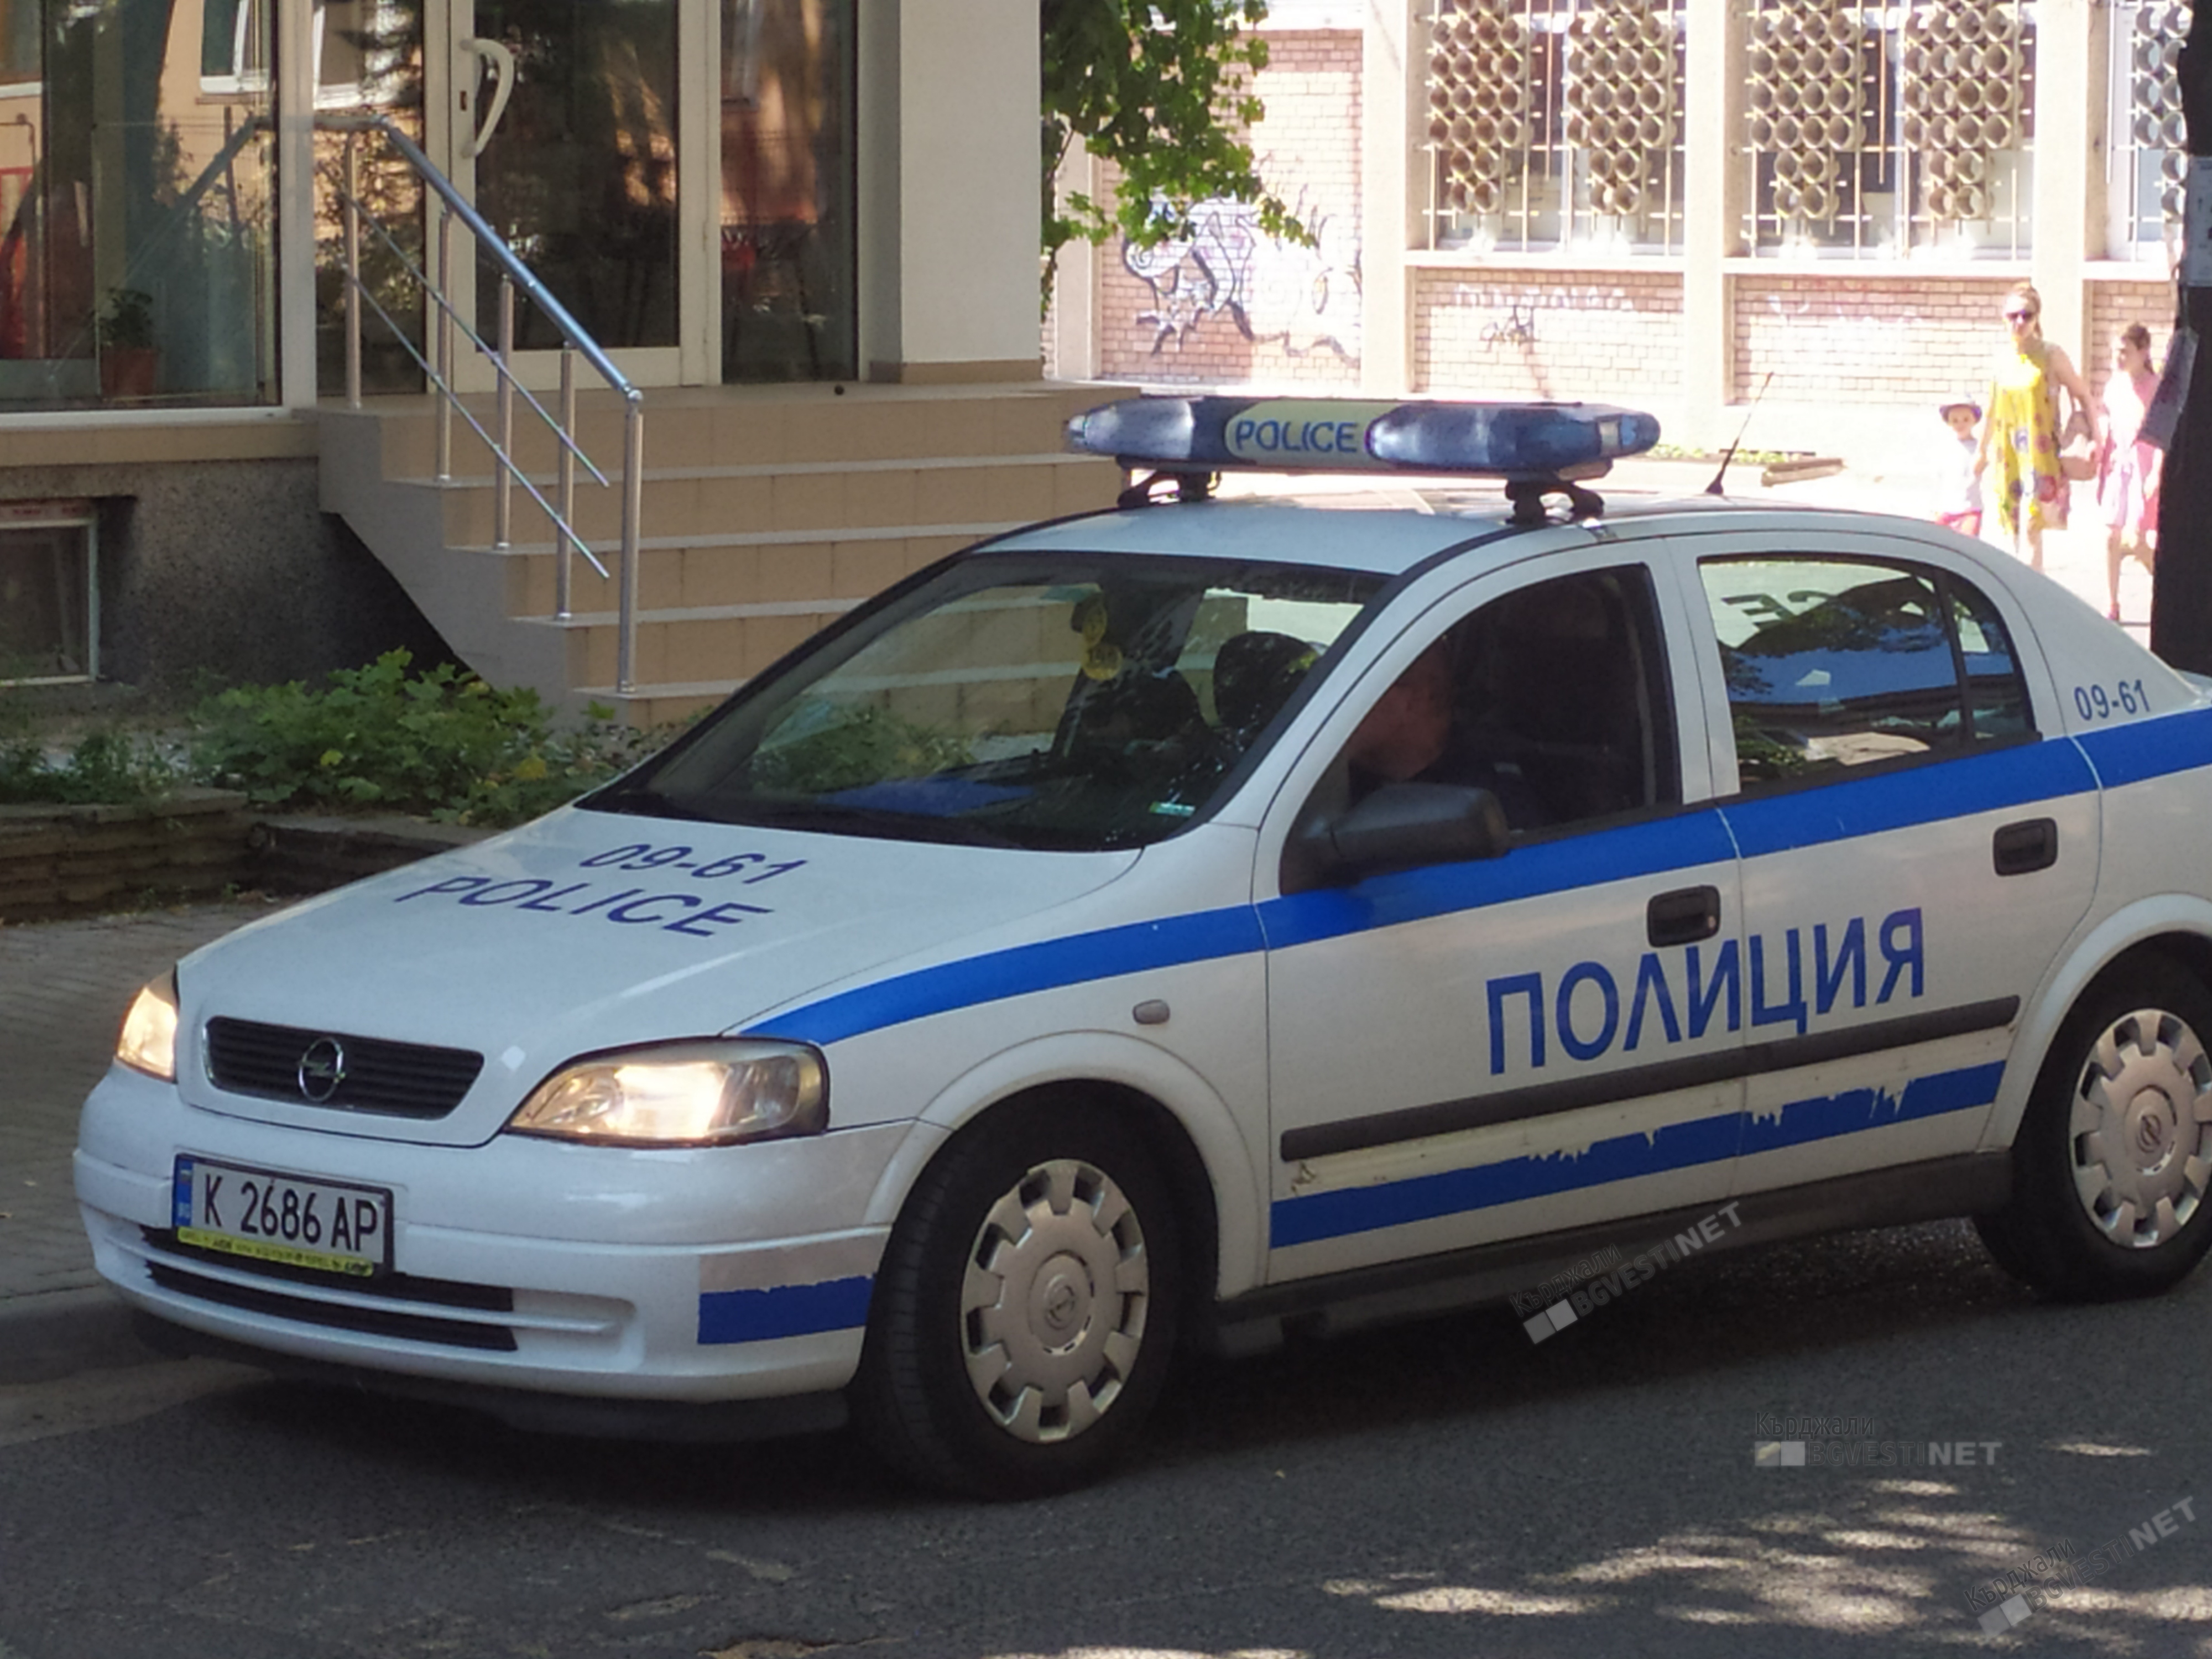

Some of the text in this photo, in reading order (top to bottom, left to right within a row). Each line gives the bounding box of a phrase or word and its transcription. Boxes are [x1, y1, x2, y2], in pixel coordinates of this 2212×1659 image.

[1235, 419, 1359, 453] POLICE
[2074, 679, 2151, 721] 09-61
[579, 843, 808, 884] 09-61
[394, 877, 775, 937] POLICE
[1486, 907, 1924, 1075] ПОЛИЦИЯ
[239, 1181, 321, 1244] 2686
